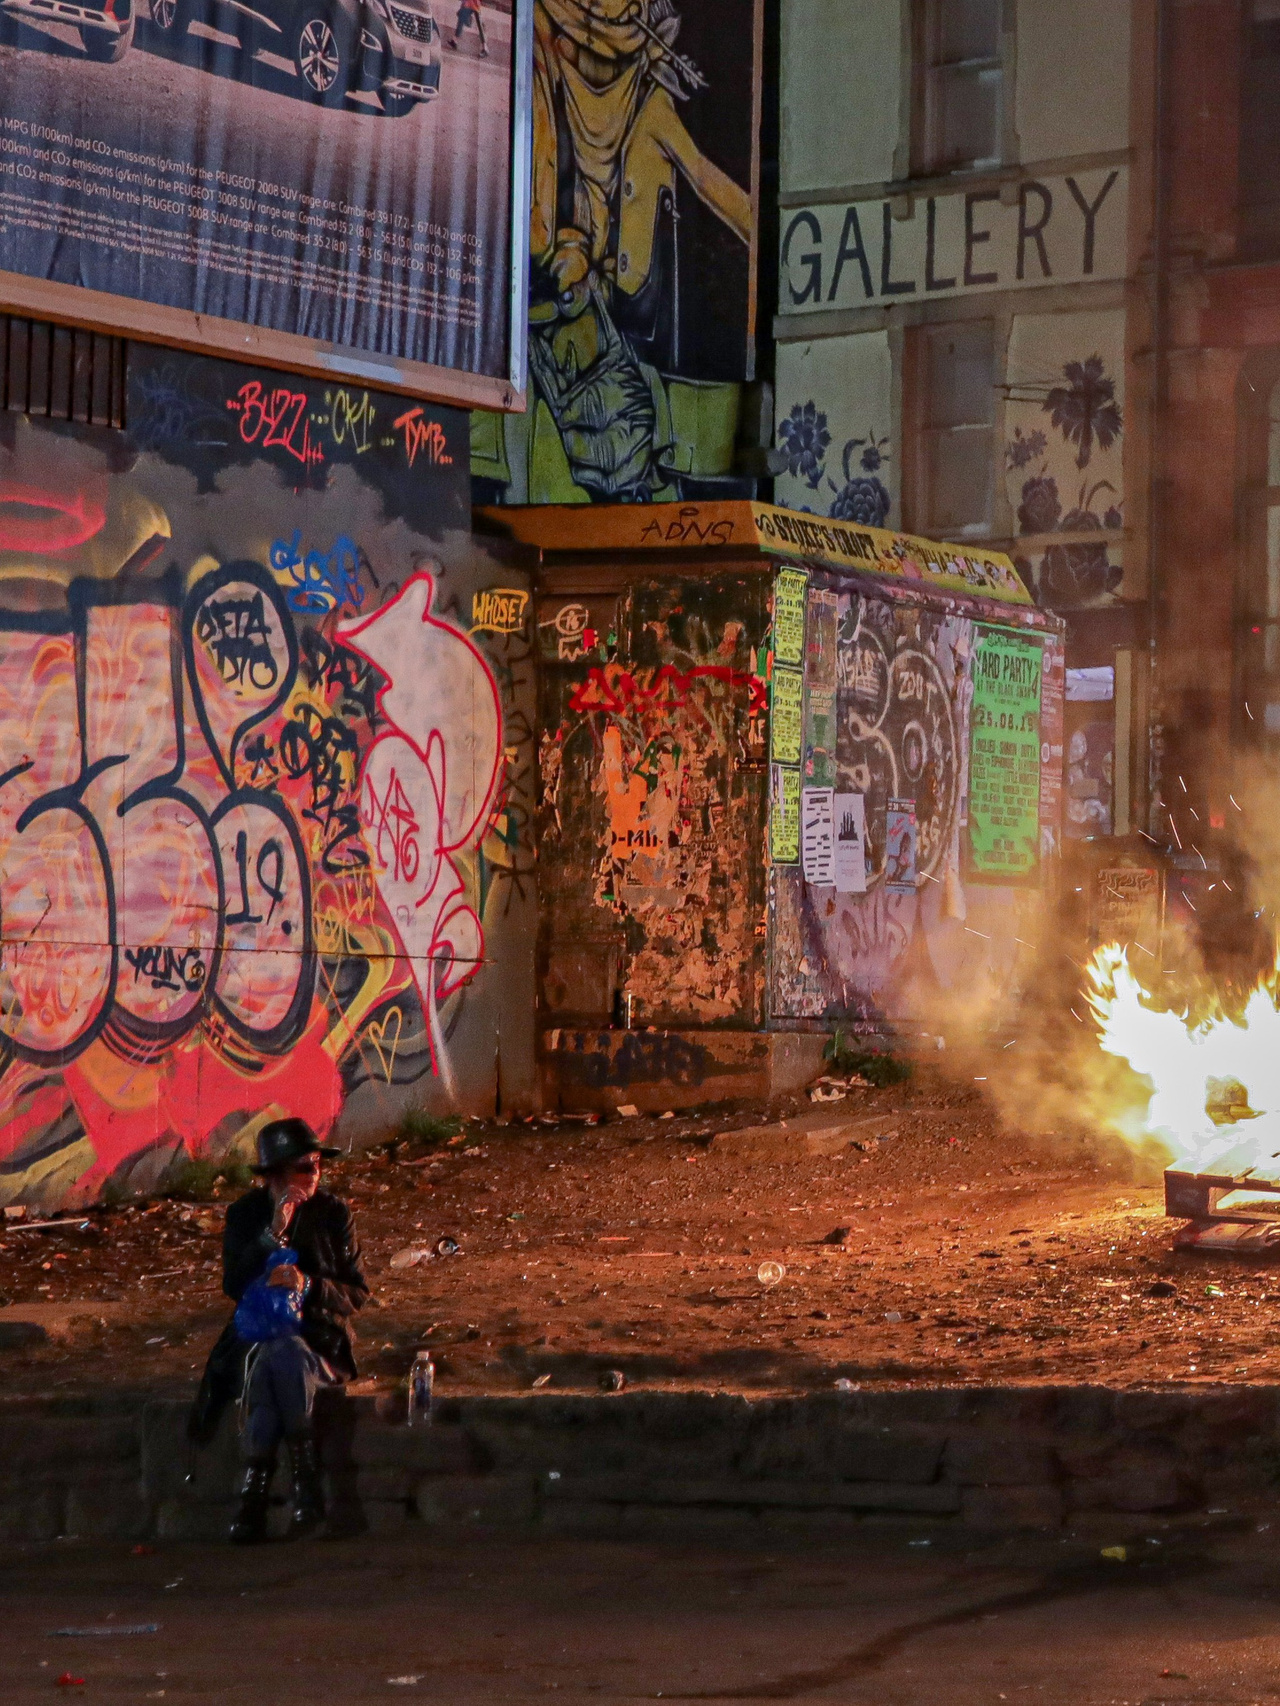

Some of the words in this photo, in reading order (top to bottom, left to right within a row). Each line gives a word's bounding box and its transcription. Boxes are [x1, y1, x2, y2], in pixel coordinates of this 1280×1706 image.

[5, 118, 28, 134] MPG
[75, 138, 91, 150] and
[113, 148, 155, 167] emissions
[158, 157, 184, 173] (g/km)
[186, 163, 198, 176] for
[199, 167, 213, 181] the
[216, 170, 255, 190] PEUGEOT
[258, 181, 279, 196] 2008
[281, 187, 298, 201] SUV
[299, 193, 321, 209] range
[339, 201, 376, 221] Combined
[450, 230, 466, 243] and
[33, 148, 49, 160] and
[72, 158, 114, 178] emissions
[115, 166, 143, 185] (g/km)
[144, 173, 157, 188] for
[158, 177, 172, 191] the
[173, 181, 214, 201] PEUGEOT
[217, 191, 238, 207] 3008
[240, 196, 257, 212] SUV
[257, 203, 280, 219] range
[298, 211, 338, 231] Combined
[414, 239, 430, 254] and
[447, 249, 461, 262] 132
[469, 253, 483, 267] 106
[39, 170, 82, 190] emissions
[83, 179, 111, 198] (g/km)
[112, 186, 125, 200] for
[127, 192, 140, 205] the
[142, 194, 185, 215] PEUGEOT
[188, 204, 208, 221] 5008
[211, 210, 228, 225] SUV
[229, 218, 252, 233] range
[271, 224, 310, 245] Combined
[391, 254, 406, 267] and
[446, 268, 461, 281] 106
[781, 171, 1119, 304] GALLERY
[832, 526, 881, 561] CROFT
[1003, 654, 1033, 684] PARTY
